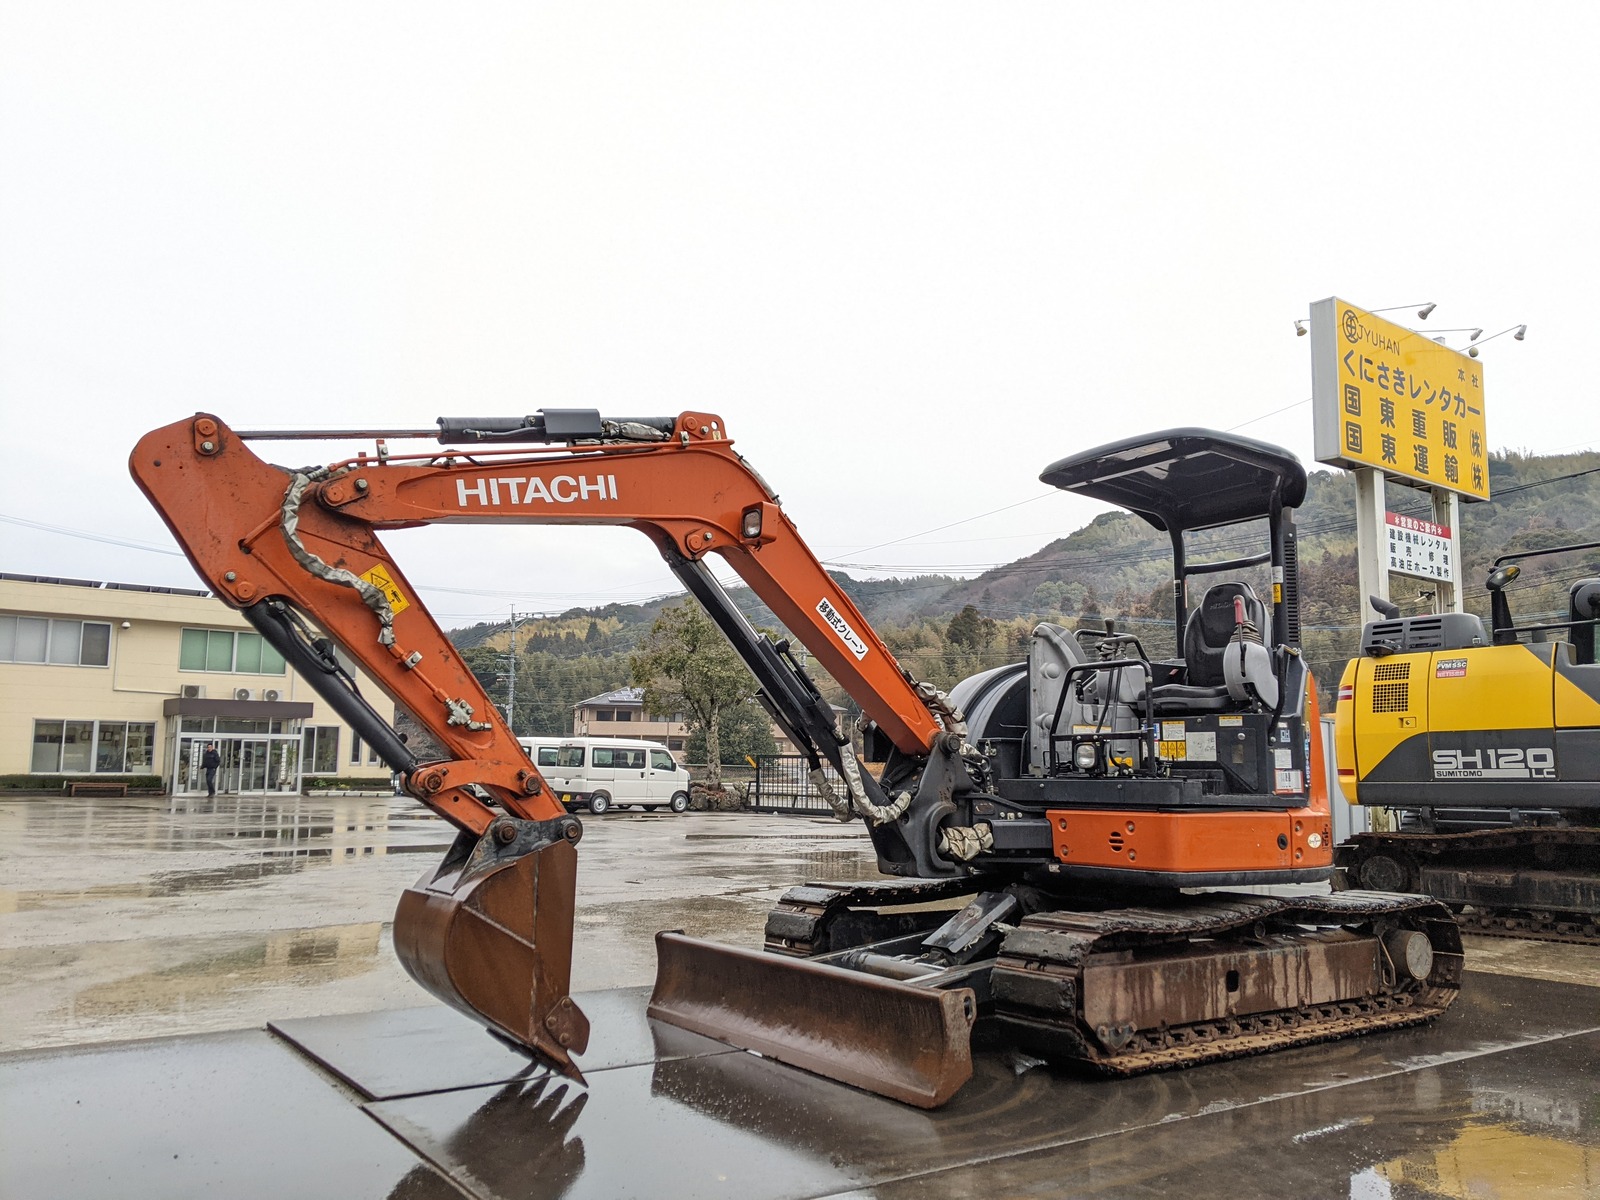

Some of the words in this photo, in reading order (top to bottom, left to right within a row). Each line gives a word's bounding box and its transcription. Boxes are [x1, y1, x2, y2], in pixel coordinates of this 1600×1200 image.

[1357, 324, 1400, 356] JYUHAN
[1343, 350, 1481, 419] くにさきレンタカー
[456, 474, 618, 507] HITACHI
[1389, 528, 1449, 551] 建設機械レンタル
[819, 600, 865, 654] 移動式クレーン
[1436, 770, 1483, 778] SUMITOMO
[1532, 769, 1556, 778] LC
